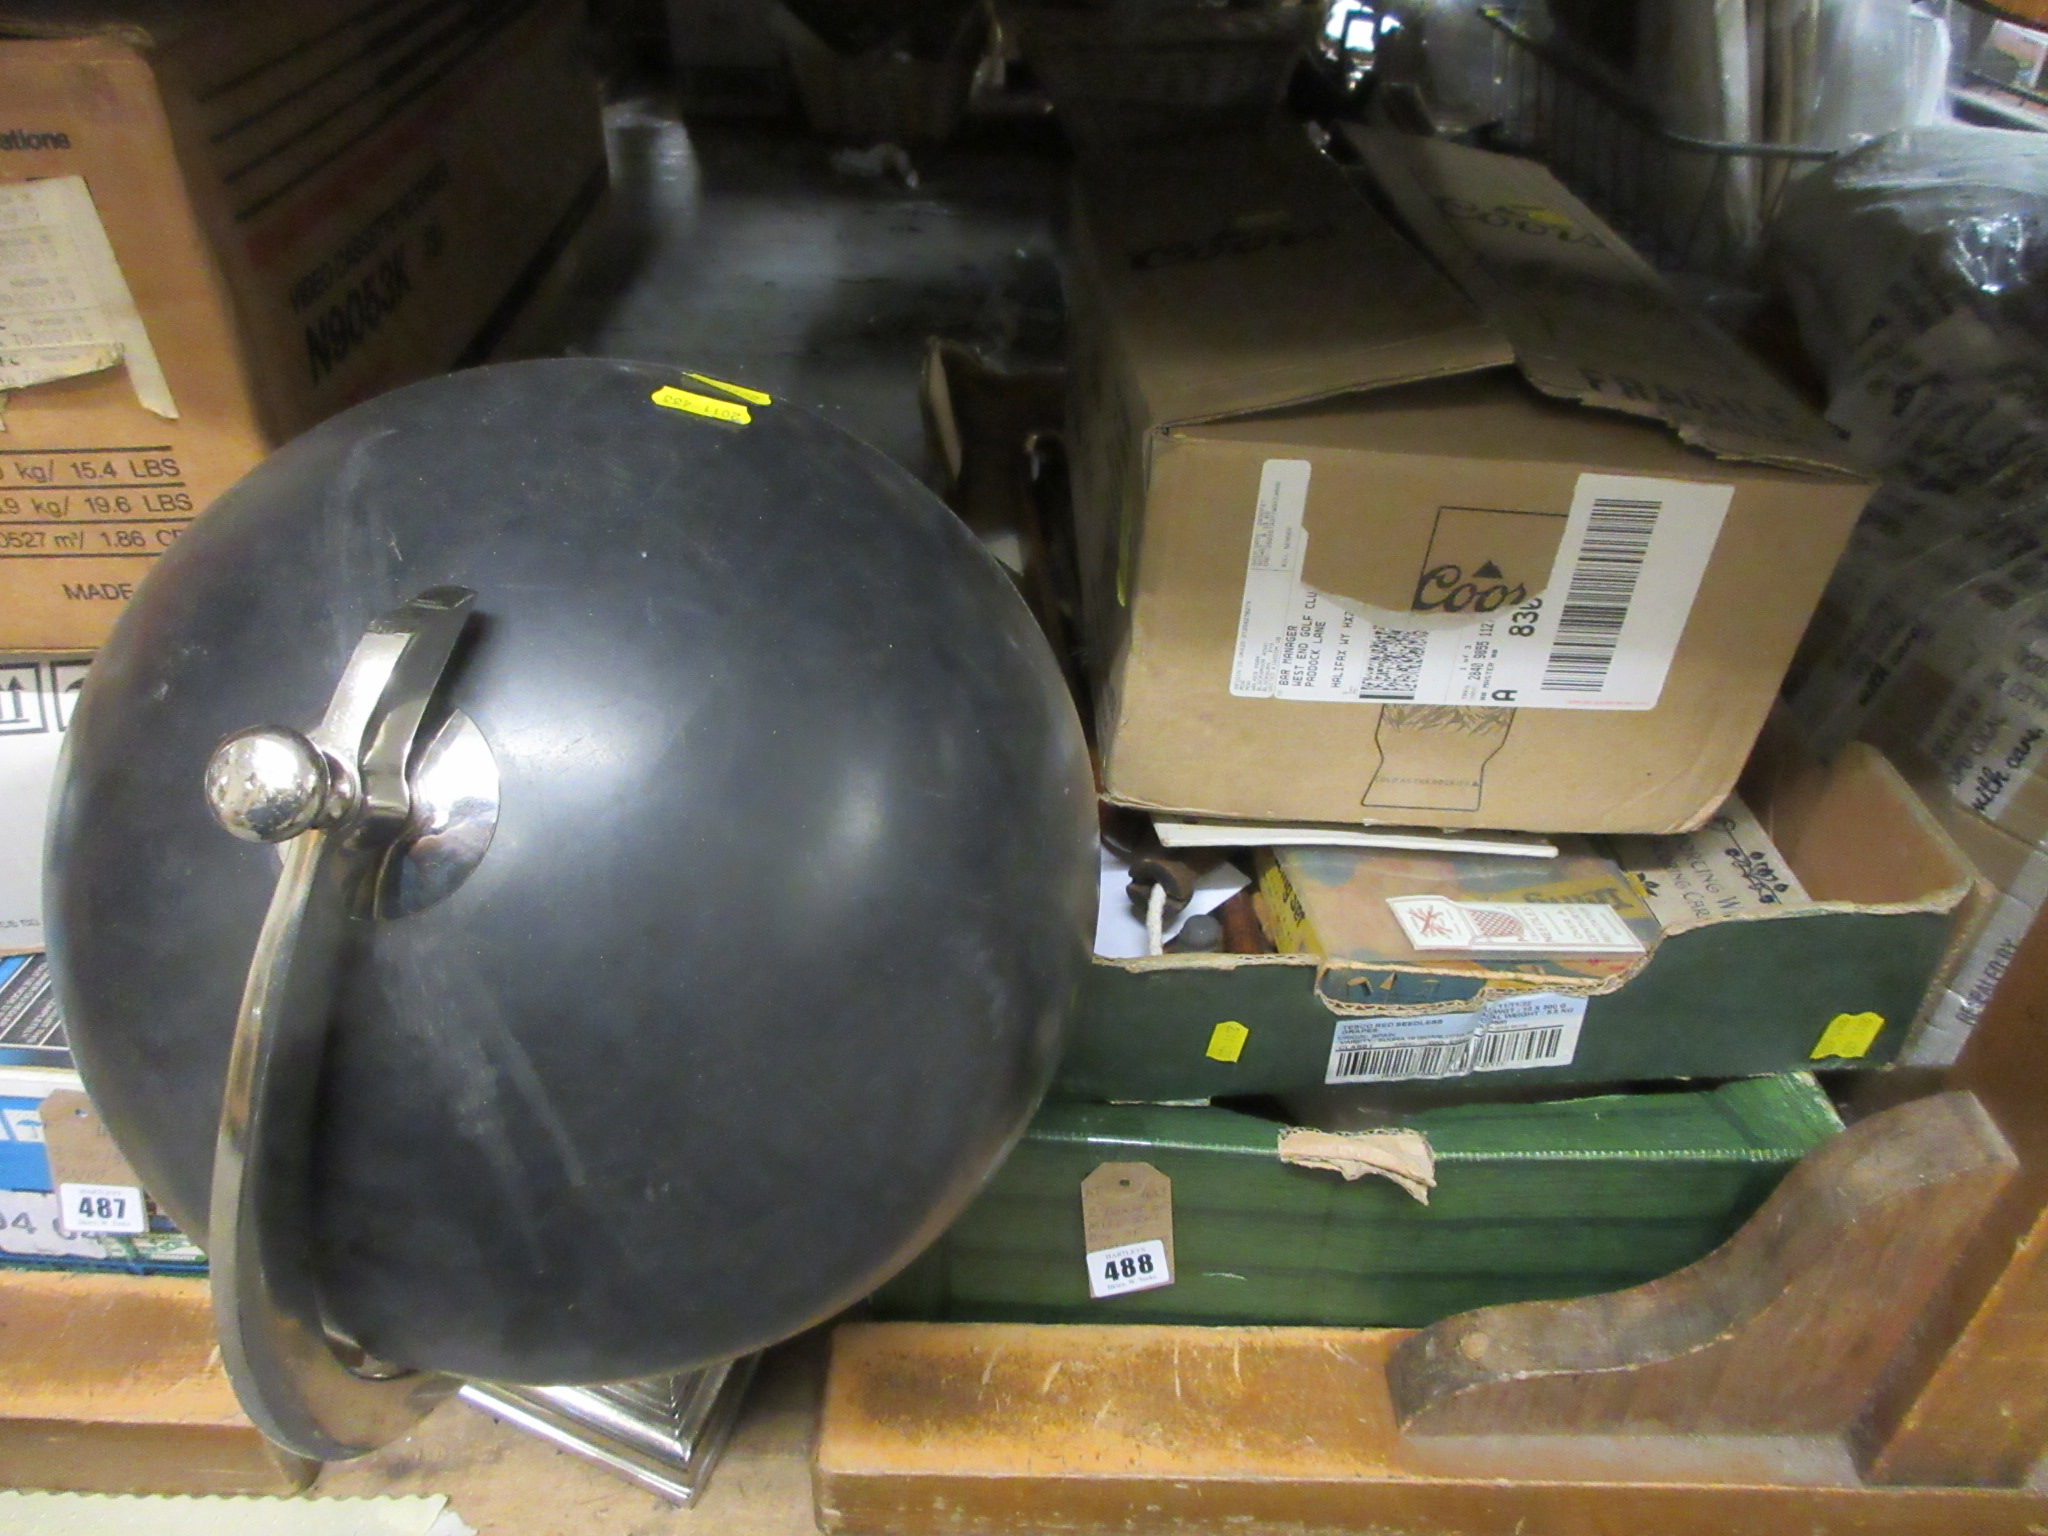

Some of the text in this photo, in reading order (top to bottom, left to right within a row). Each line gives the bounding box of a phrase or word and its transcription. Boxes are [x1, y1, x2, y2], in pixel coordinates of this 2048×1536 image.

[71, 461, 117, 479] 15.4
[130, 458, 181, 478] LBS
[85, 496, 132, 514] 19.6
[144, 493, 193, 511] LBS
[100, 531, 146, 547] 1.86
[62, 583, 134, 600] MADE
[1300, 615, 1313, 637] GOLF
[1279, 625, 1298, 685] BAR MANAGER
[1296, 642, 1308, 659] END
[1305, 621, 1326, 687] PADDOCK LANE
[1292, 665, 1304, 687] WEST
[1331, 650, 1347, 688] HALIFAX
[1482, 661, 1495, 688] MASTER
[1491, 689, 1518, 702] A
[1394, 1019, 1443, 1028] SEEDLESS
[79, 1197, 126, 1219] 487
[1104, 1253, 1154, 1281] 488
